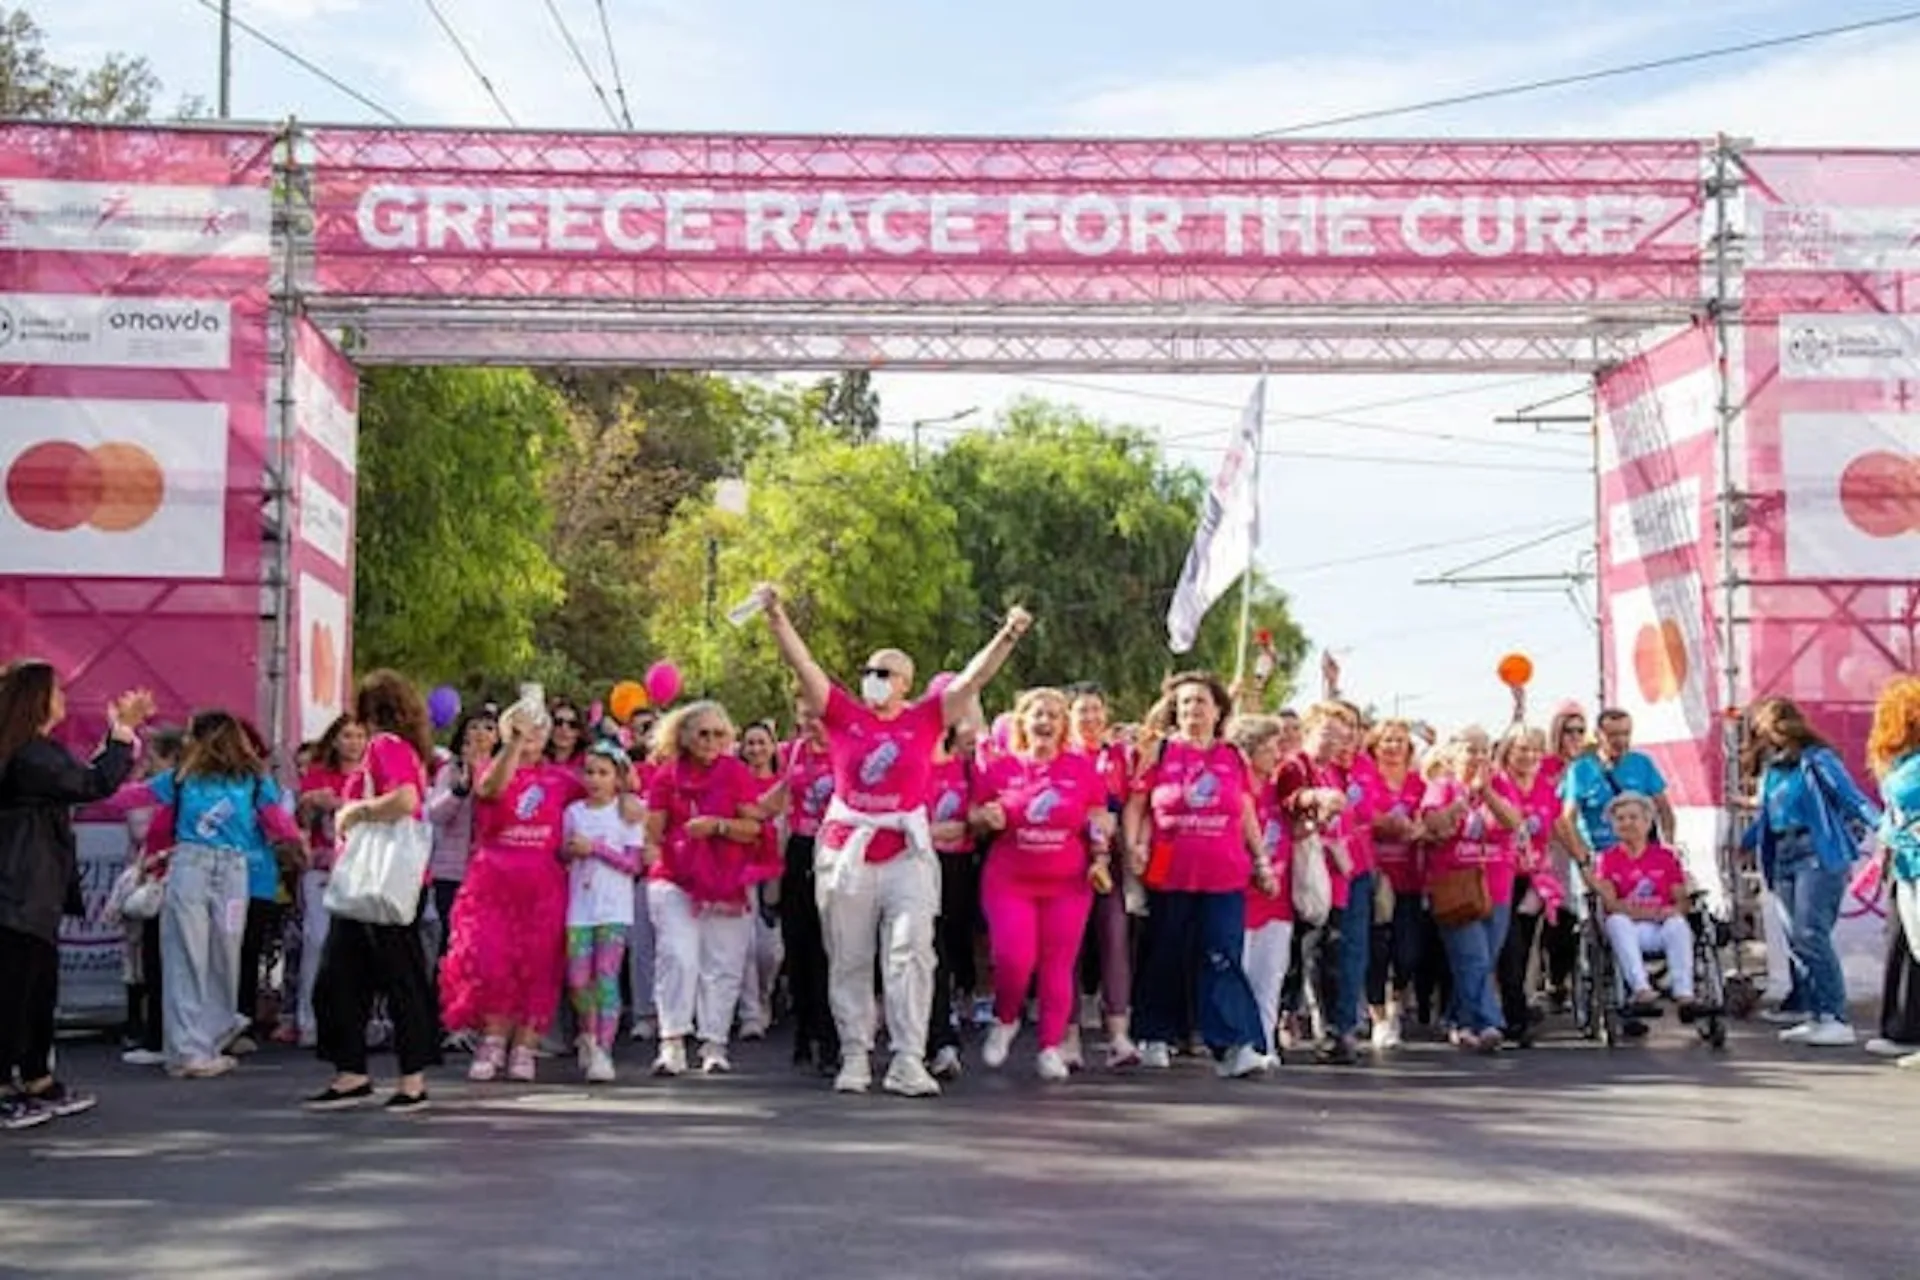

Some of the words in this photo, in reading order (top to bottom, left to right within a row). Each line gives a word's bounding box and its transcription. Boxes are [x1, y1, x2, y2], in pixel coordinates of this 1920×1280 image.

[356, 183, 716, 252] GREECE
[745, 190, 981, 256] RACE
[1009, 192, 1184, 256] FOR
[1209, 194, 1377, 258] THE
[1402, 194, 1640, 258] CURE
